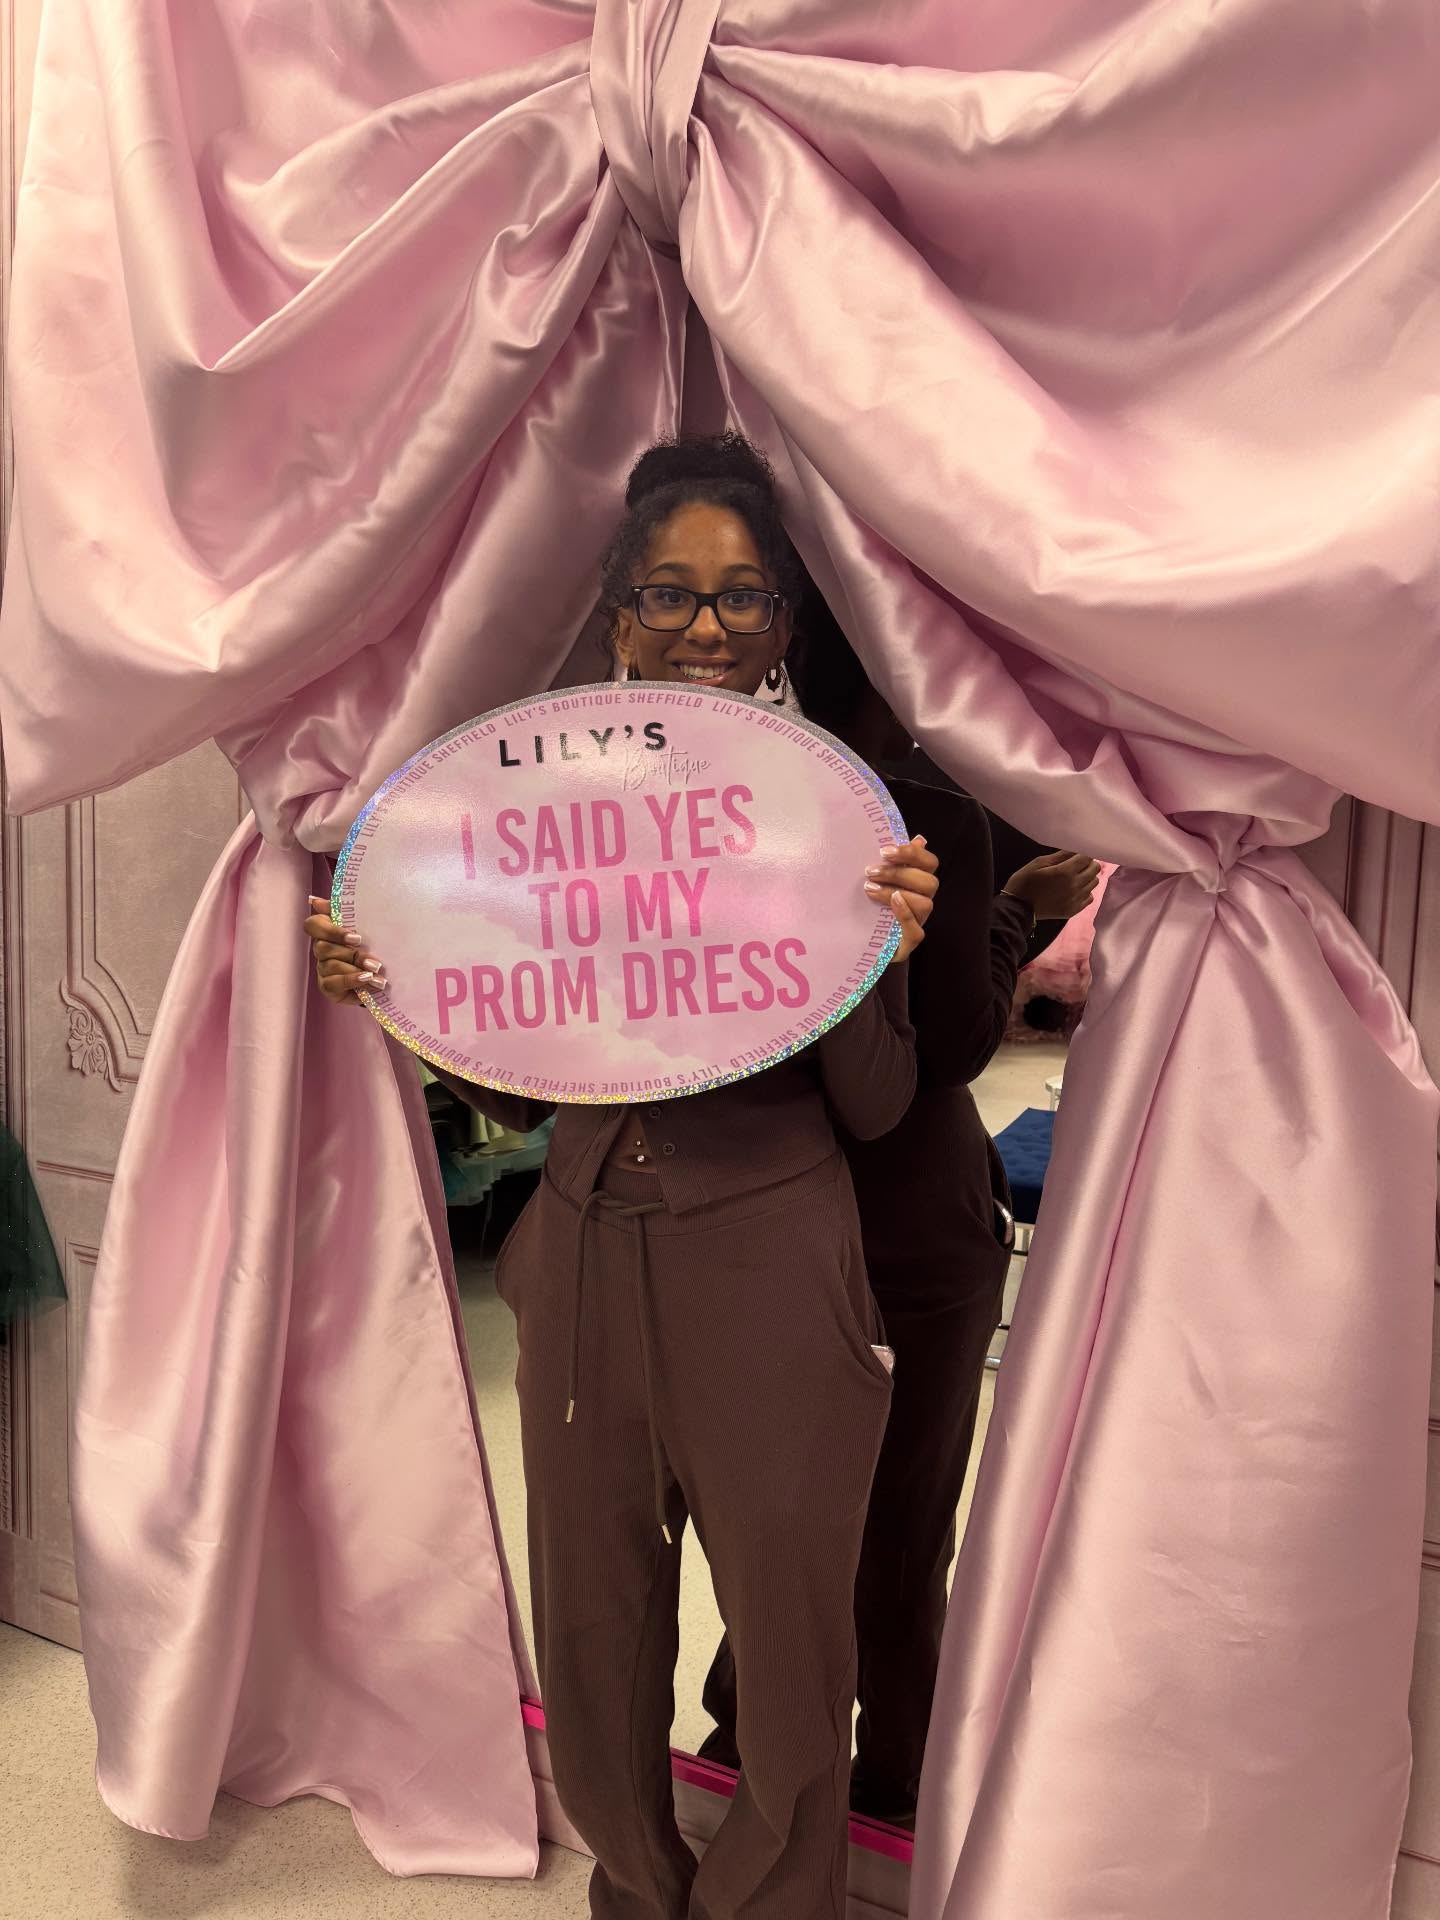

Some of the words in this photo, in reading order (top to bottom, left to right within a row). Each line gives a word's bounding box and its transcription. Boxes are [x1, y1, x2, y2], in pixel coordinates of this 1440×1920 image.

[503, 705, 547, 727] LILY'S
[552, 693, 622, 712] BOUTIQUE
[627, 692, 703, 708] SHEFFIELD
[433, 723, 497, 763] SHEFFIELD
[498, 721, 668, 768] LILY'S
[712, 702, 757, 721] LILY'S
[757, 714, 819, 752] BOUTIQUE
[817, 748, 868, 796] SHEFFIELD
[460, 813, 477, 880] I
[497, 799, 628, 877] SAID
[645, 784, 757, 863] YES
[863, 800, 891, 834] LILY'S
[342, 844, 367, 896] SHEFFIELD
[528, 877, 601, 950] TO
[625, 868, 709, 942] MY
[435, 955, 599, 1035] PROM
[622, 937, 811, 1021] DRESS
[847, 951, 877, 986] LILY'S
[797, 983, 853, 1032] BOUTIQUE
[413, 1029, 472, 1067] BOUTIQUE
[730, 1030, 800, 1068] SHEFFIELD
[472, 1060, 513, 1083] LILY'S
[523, 1076, 596, 1094] SHEFFIELD
[601, 1077, 672, 1094] BOUTIQUE
[676, 1064, 721, 1085] LILY'S
